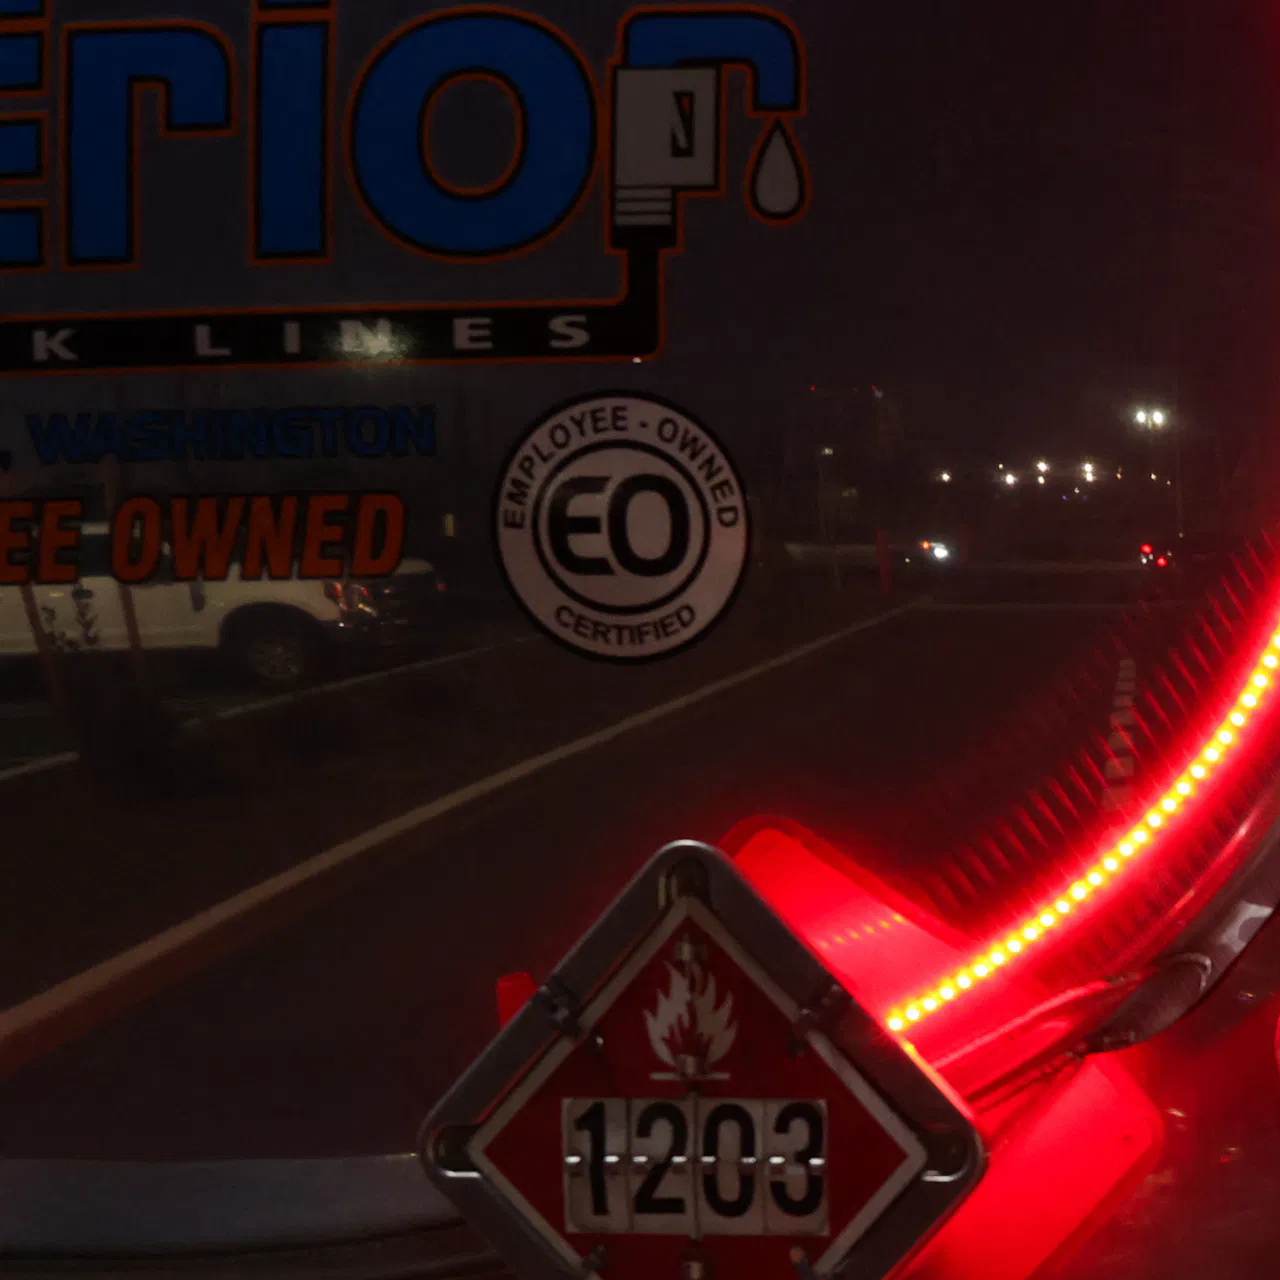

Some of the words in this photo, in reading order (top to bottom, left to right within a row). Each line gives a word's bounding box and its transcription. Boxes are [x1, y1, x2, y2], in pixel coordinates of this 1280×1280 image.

[195, 314, 590, 361] LINES
[27, 406, 437, 466] WASHINGTON
[503, 405, 630, 530] EMPLOYEE
[656, 417, 740, 529] OWNED
[110, 492, 408, 584] OWNED
[547, 473, 690, 577] EO
[554, 603, 697, 646] CERTIFIED
[573, 1101, 827, 1218] 1203
